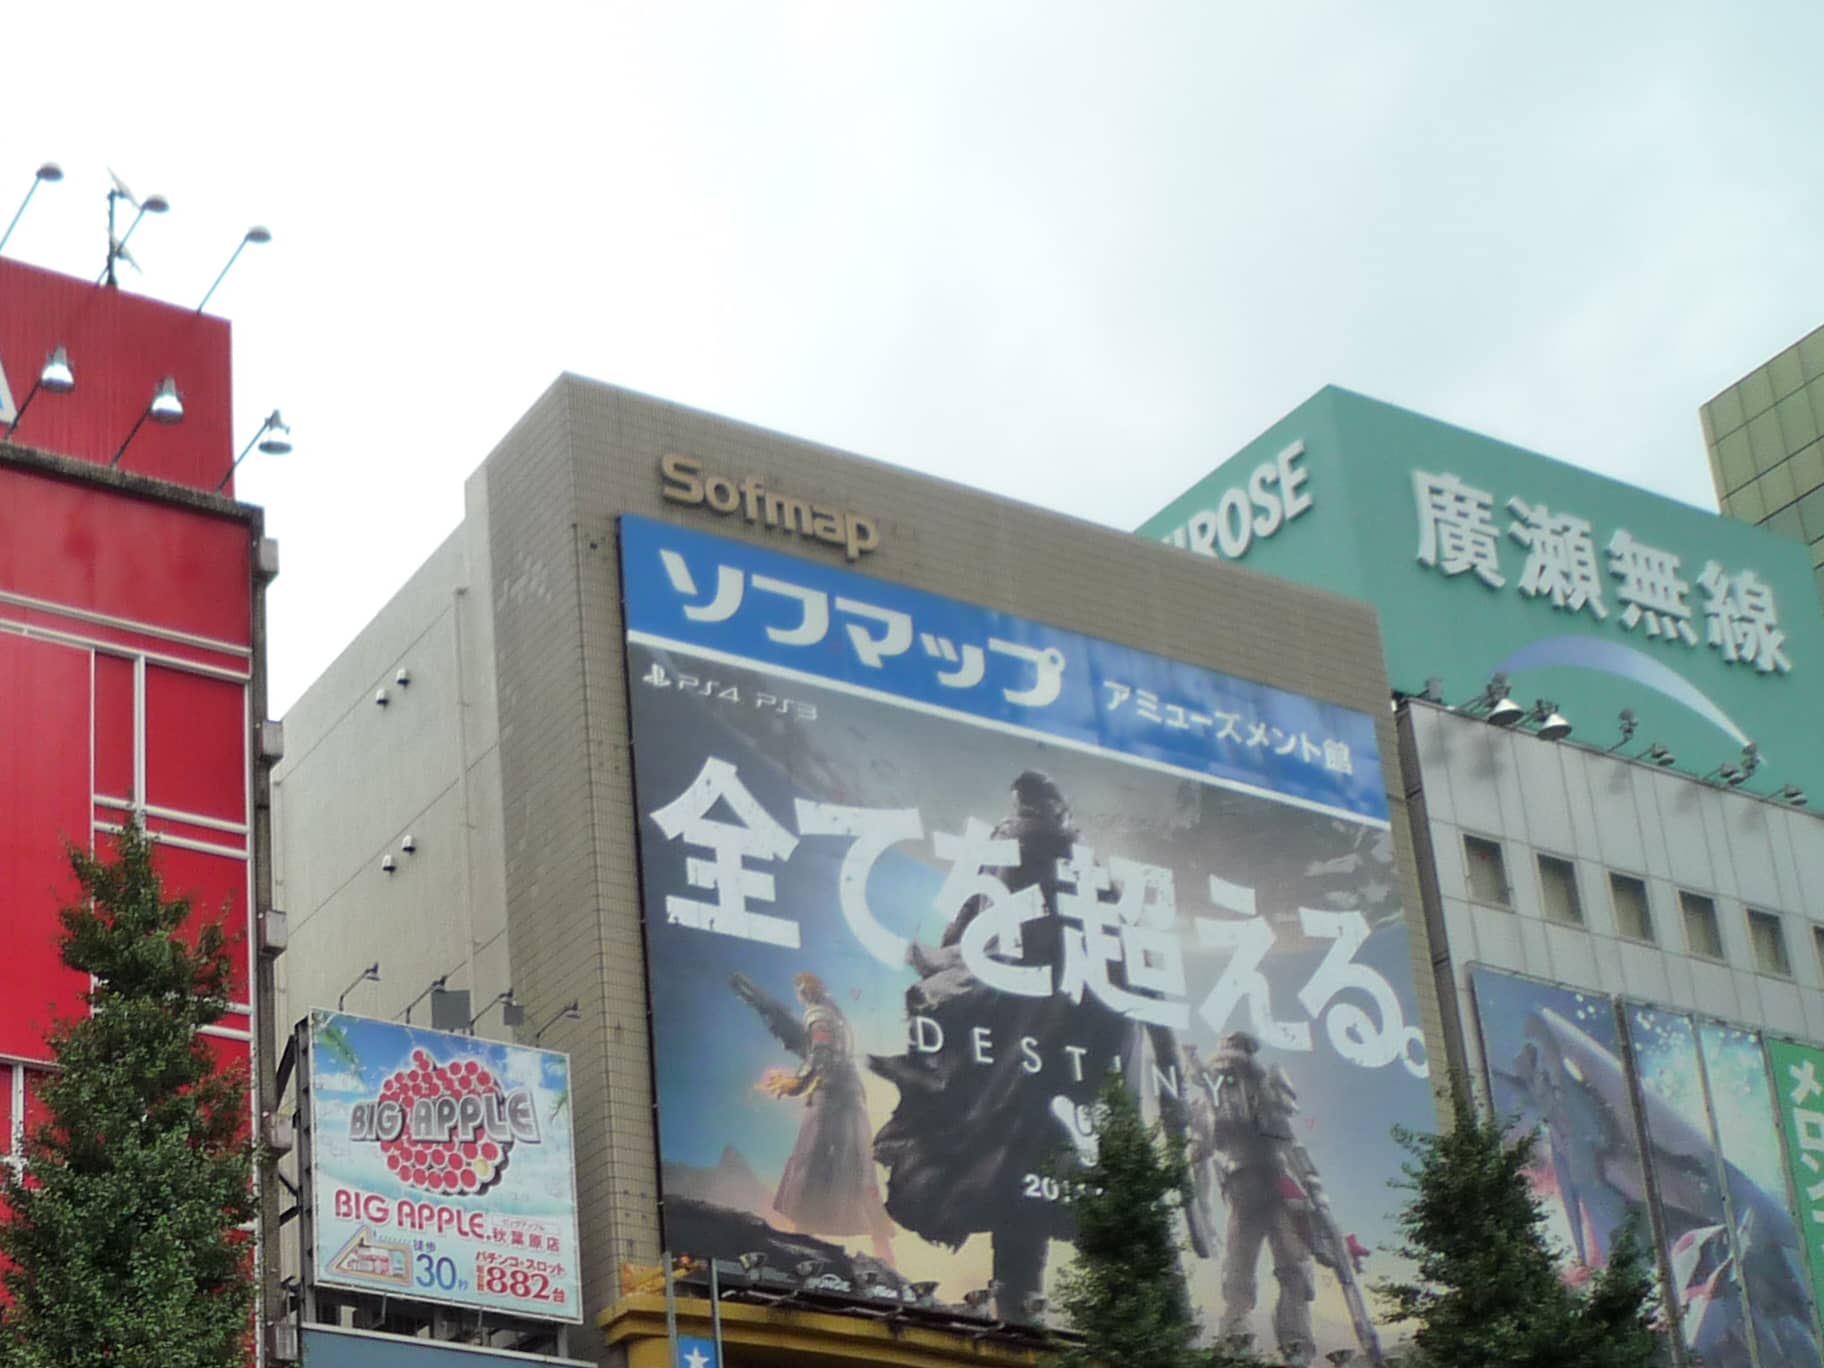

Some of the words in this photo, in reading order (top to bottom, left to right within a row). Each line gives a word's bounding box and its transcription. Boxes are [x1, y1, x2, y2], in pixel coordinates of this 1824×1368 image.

[659, 450, 881, 560] Sofmap
[1412, 468, 1792, 676] 廣瀬無線
[659, 546, 1064, 710] ソフマップ
[1102, 680, 1355, 776] アミューズメント館
[651, 756, 1430, 1080] 全てを超える。
[350, 1099, 406, 1143] BIG
[413, 1089, 541, 1143] APPLE
[335, 1189, 389, 1224] BIG
[492, 1228, 560, 1253] 秋葉原店
